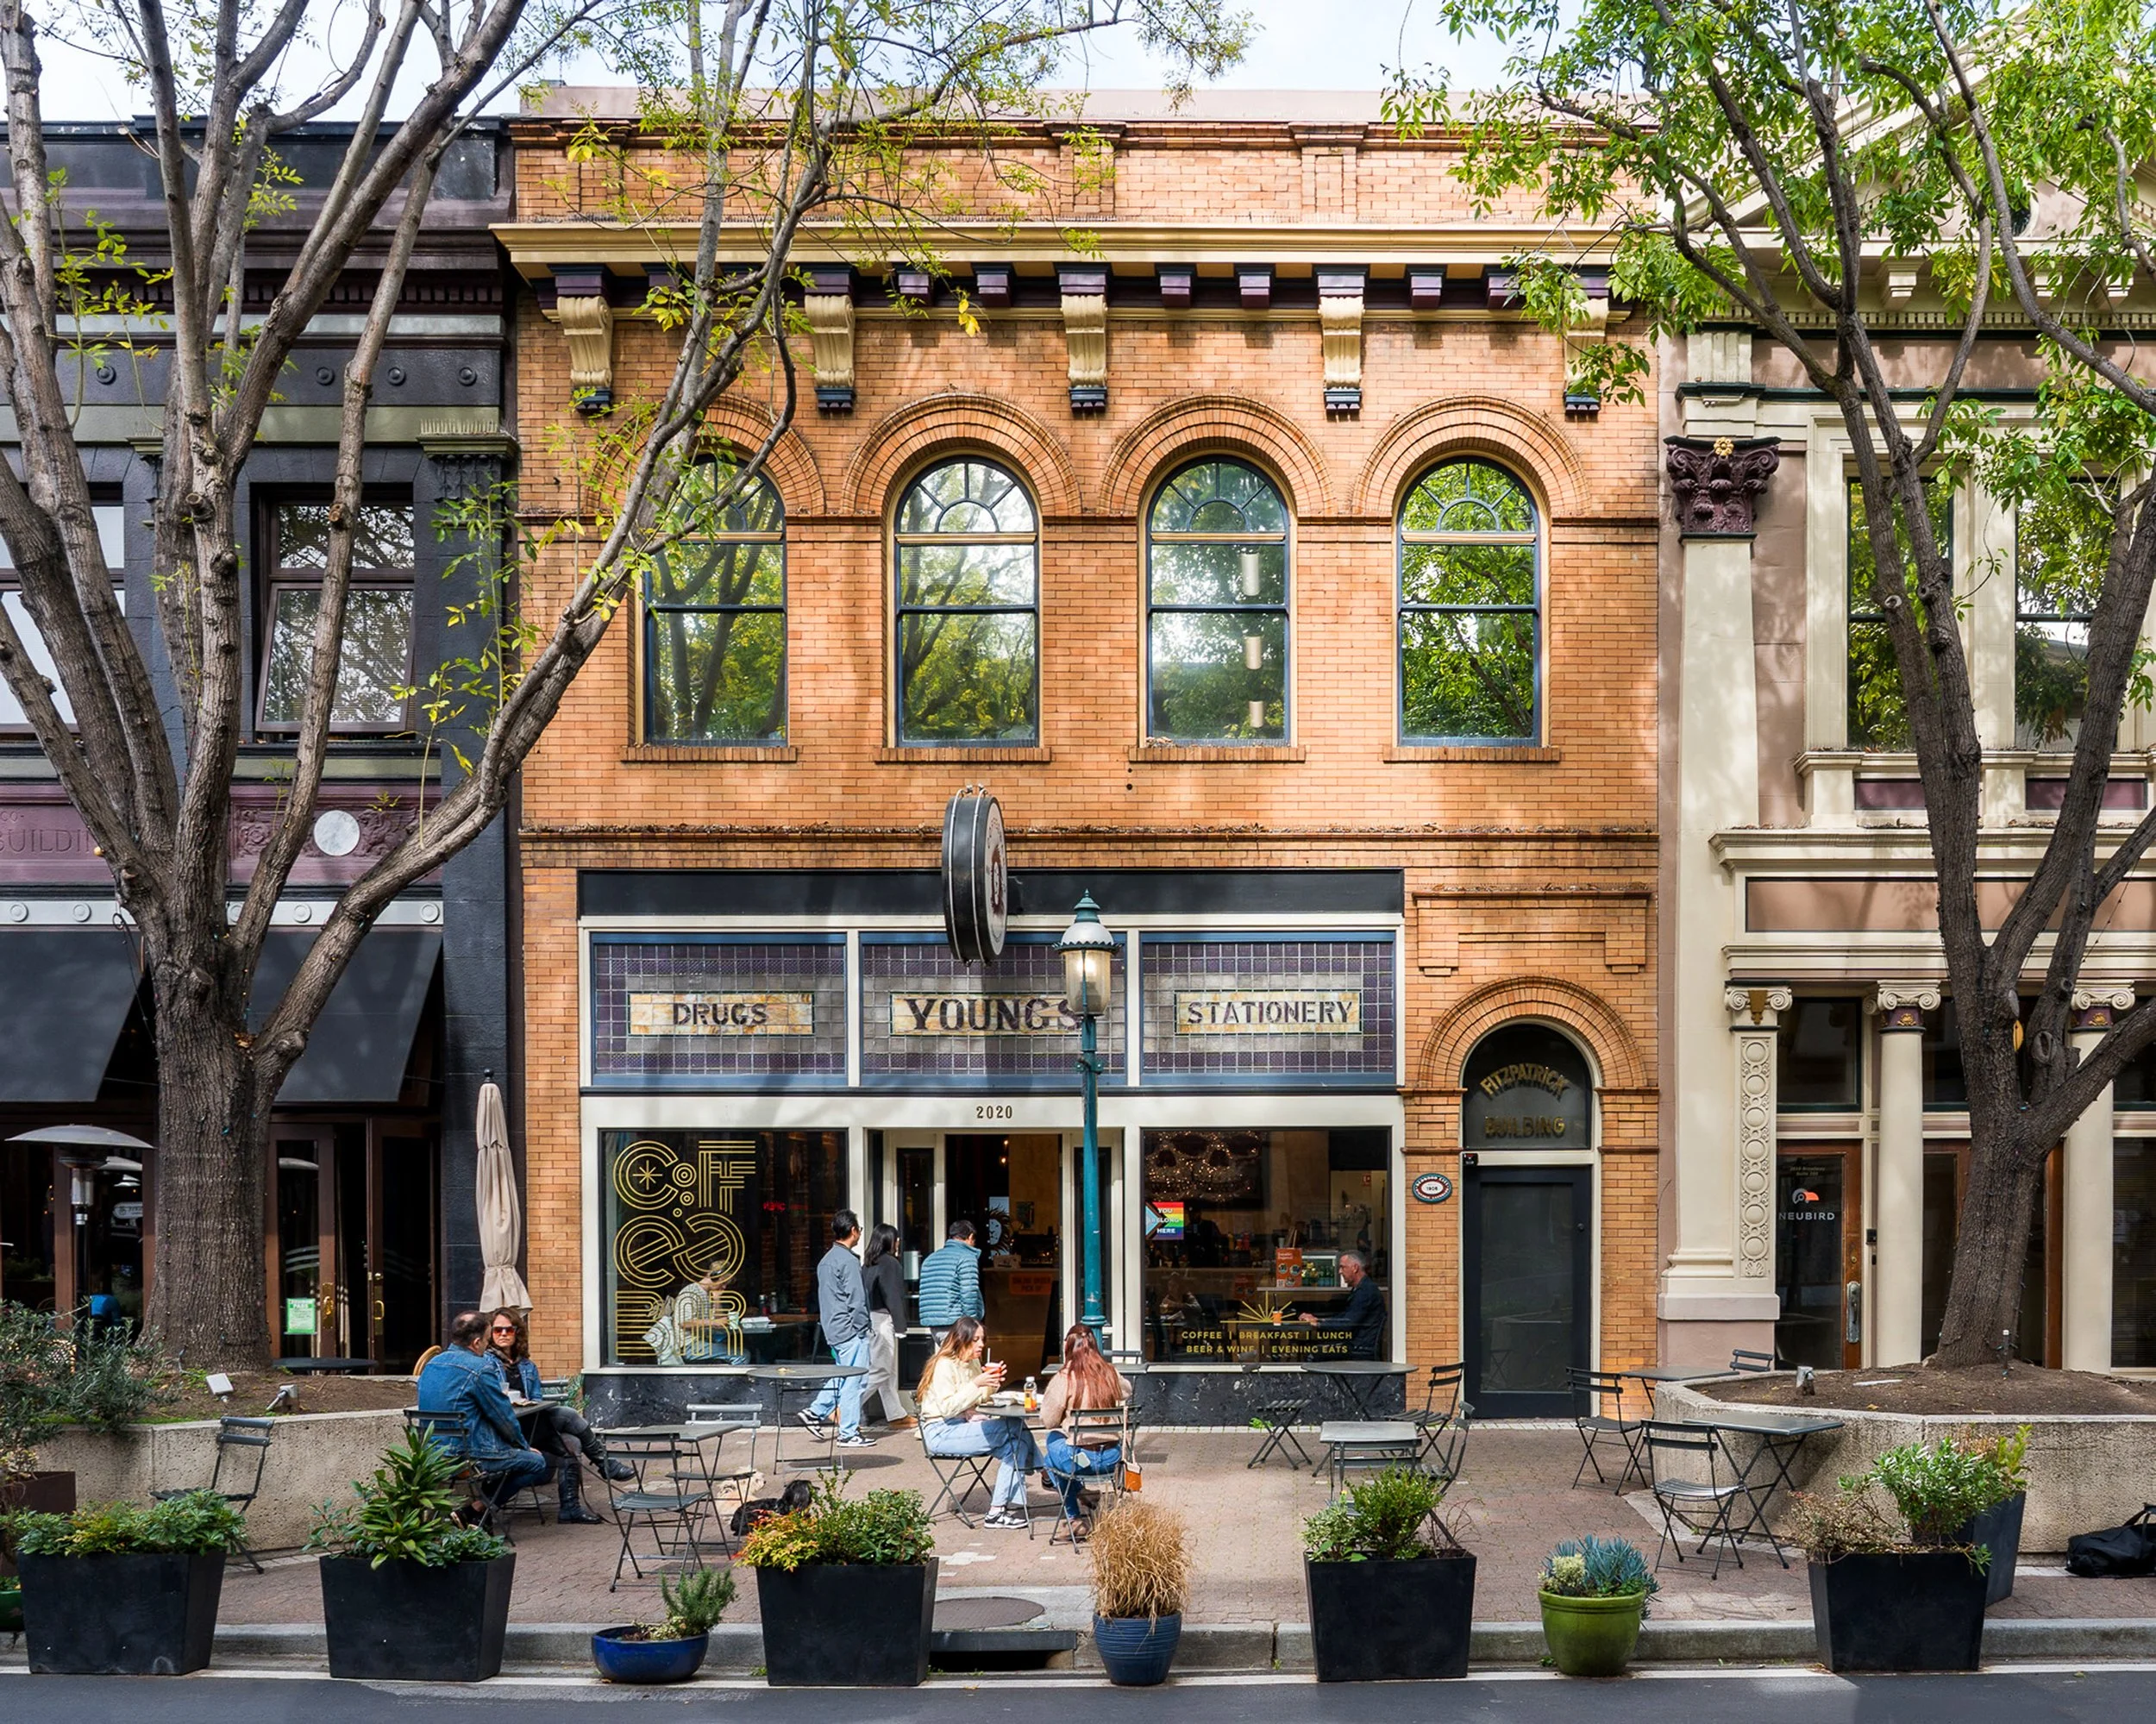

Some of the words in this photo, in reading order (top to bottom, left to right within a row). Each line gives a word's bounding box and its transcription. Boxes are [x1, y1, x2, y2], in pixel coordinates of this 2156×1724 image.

[673, 1003, 768, 1025] DRUGS
[1187, 1001, 1352, 1024] STATIONERY
[1480, 1063, 1570, 1098] FITZPATRICK
[976, 1106, 1012, 1119] 2020
[1485, 1117, 1566, 1137] BUILDING
[1778, 1212, 1835, 1220] NEUBIRD
[615, 1290, 747, 1356] BAR
